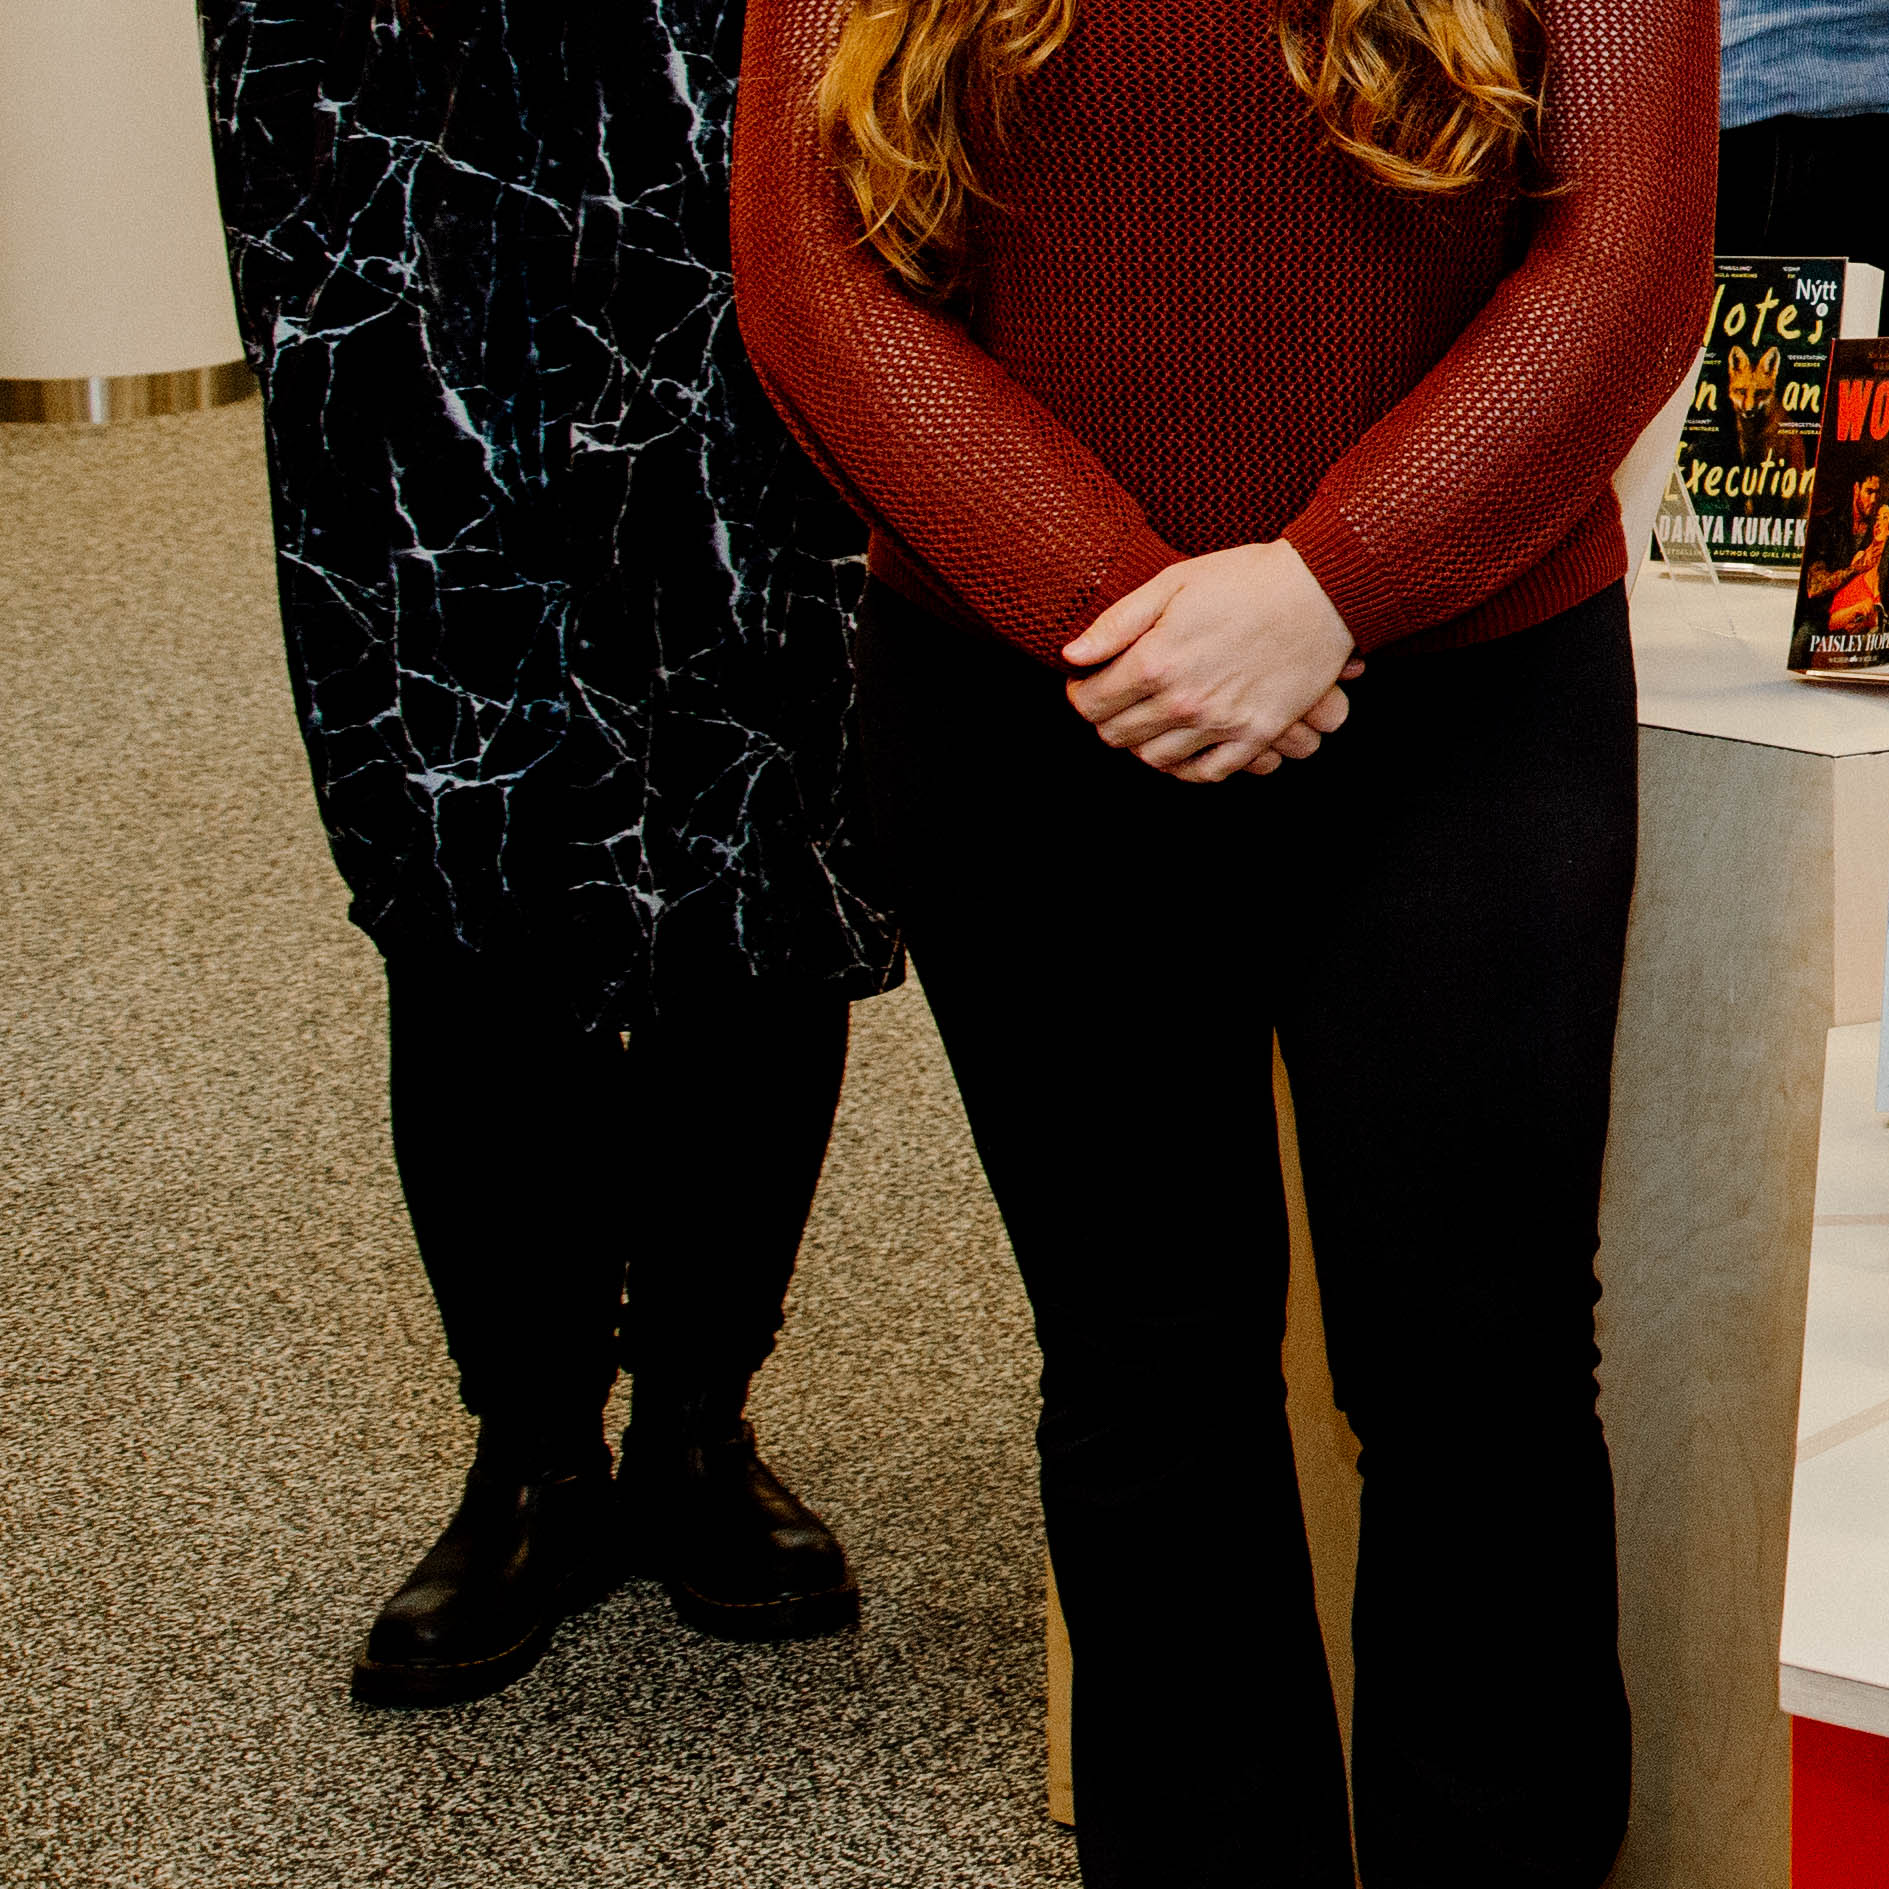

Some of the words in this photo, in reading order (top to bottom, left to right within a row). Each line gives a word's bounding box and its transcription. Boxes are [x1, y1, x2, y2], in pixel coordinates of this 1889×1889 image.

[1795, 278, 1837, 305] Nýtt
[1782, 381, 1820, 412] an
[1810, 633, 1864, 653] PAISLEY
